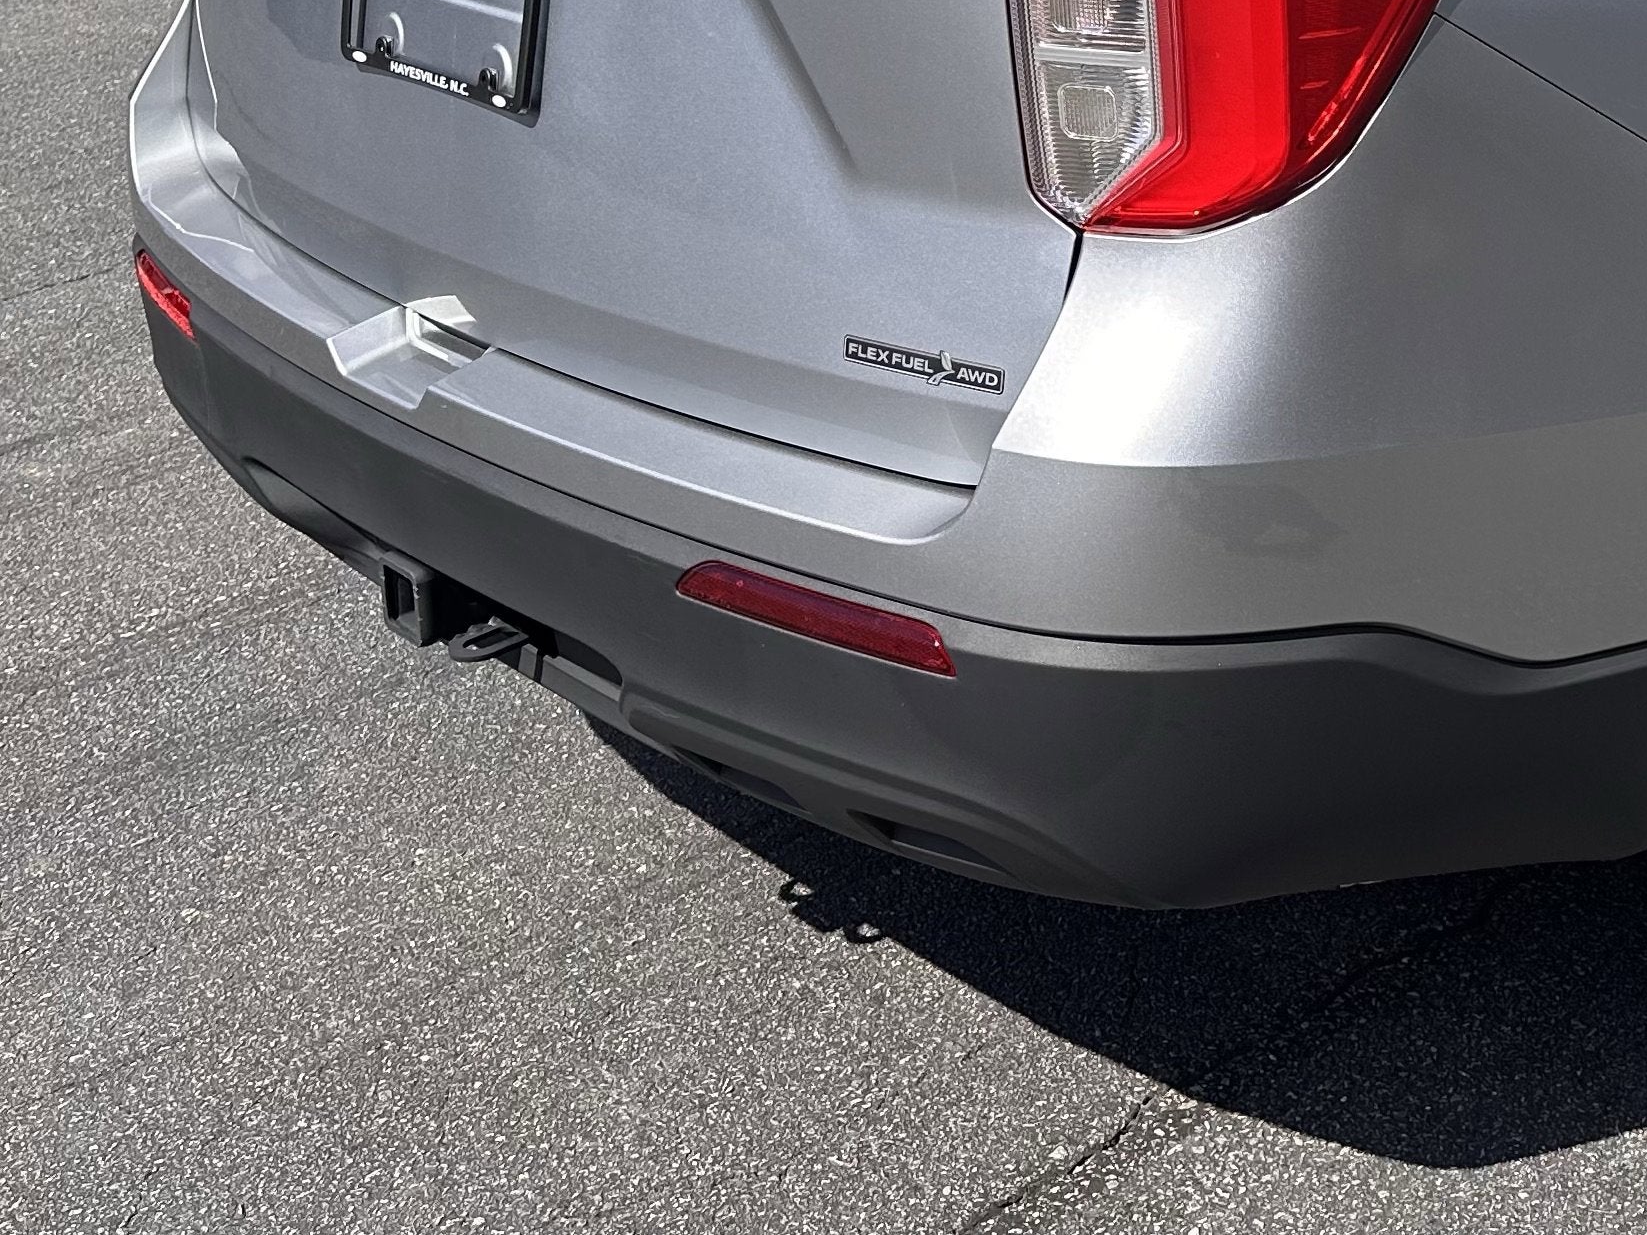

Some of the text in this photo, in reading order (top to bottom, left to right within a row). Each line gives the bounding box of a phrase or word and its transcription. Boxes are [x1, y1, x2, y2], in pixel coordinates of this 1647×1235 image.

[449, 79, 470, 97] N.C.
[847, 341, 1000, 387] FLEX FUEL AWD
